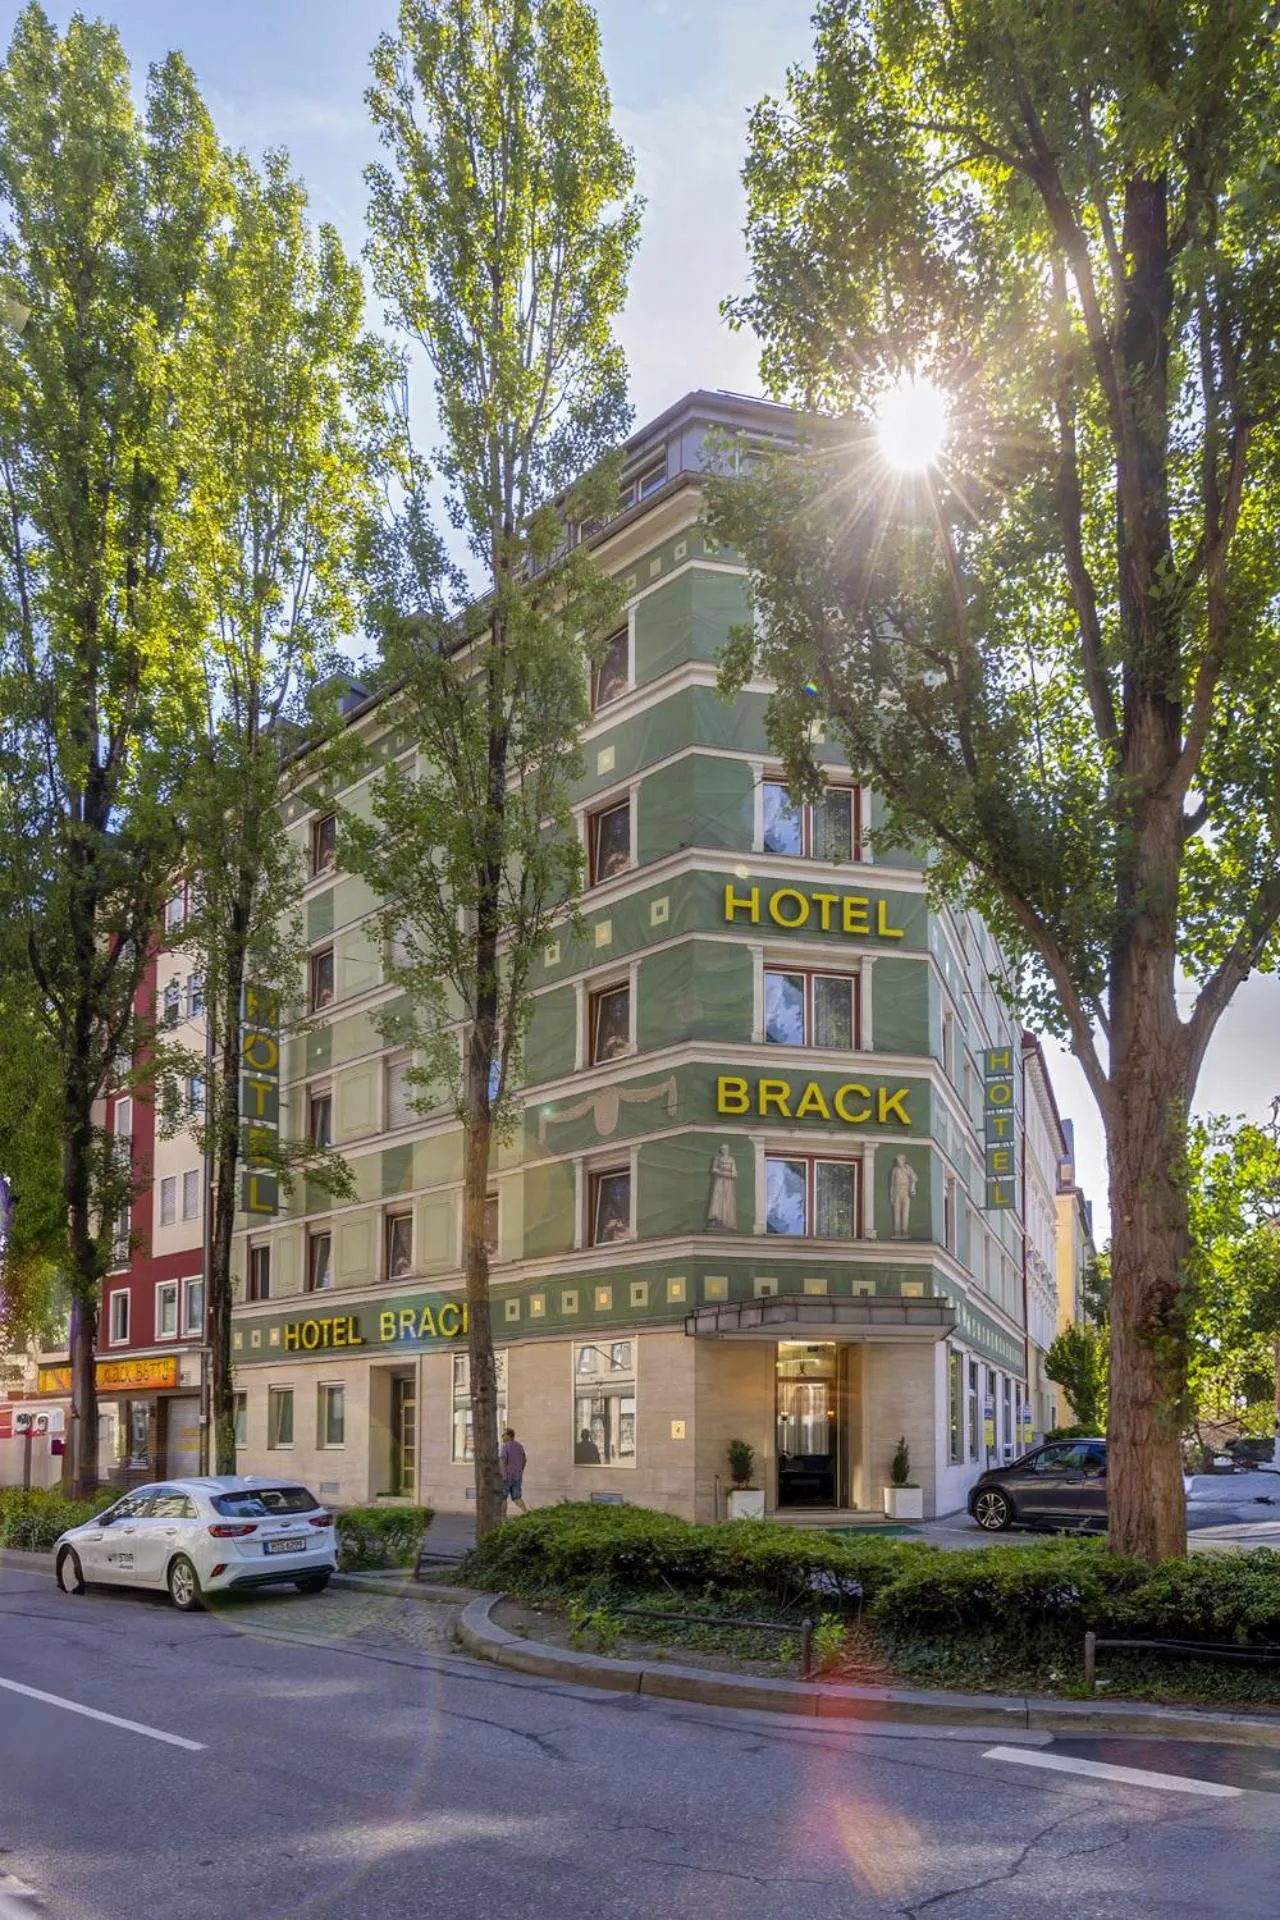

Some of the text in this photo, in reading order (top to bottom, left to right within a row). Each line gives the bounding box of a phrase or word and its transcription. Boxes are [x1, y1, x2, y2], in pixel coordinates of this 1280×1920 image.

[725, 884, 905, 938] HOTEL
[244, 988, 279, 1211] HOTEL
[717, 1075, 912, 1126] BRACK
[989, 1051, 1011, 1205] HOTEL
[284, 1316, 363, 1350] HOTEL
